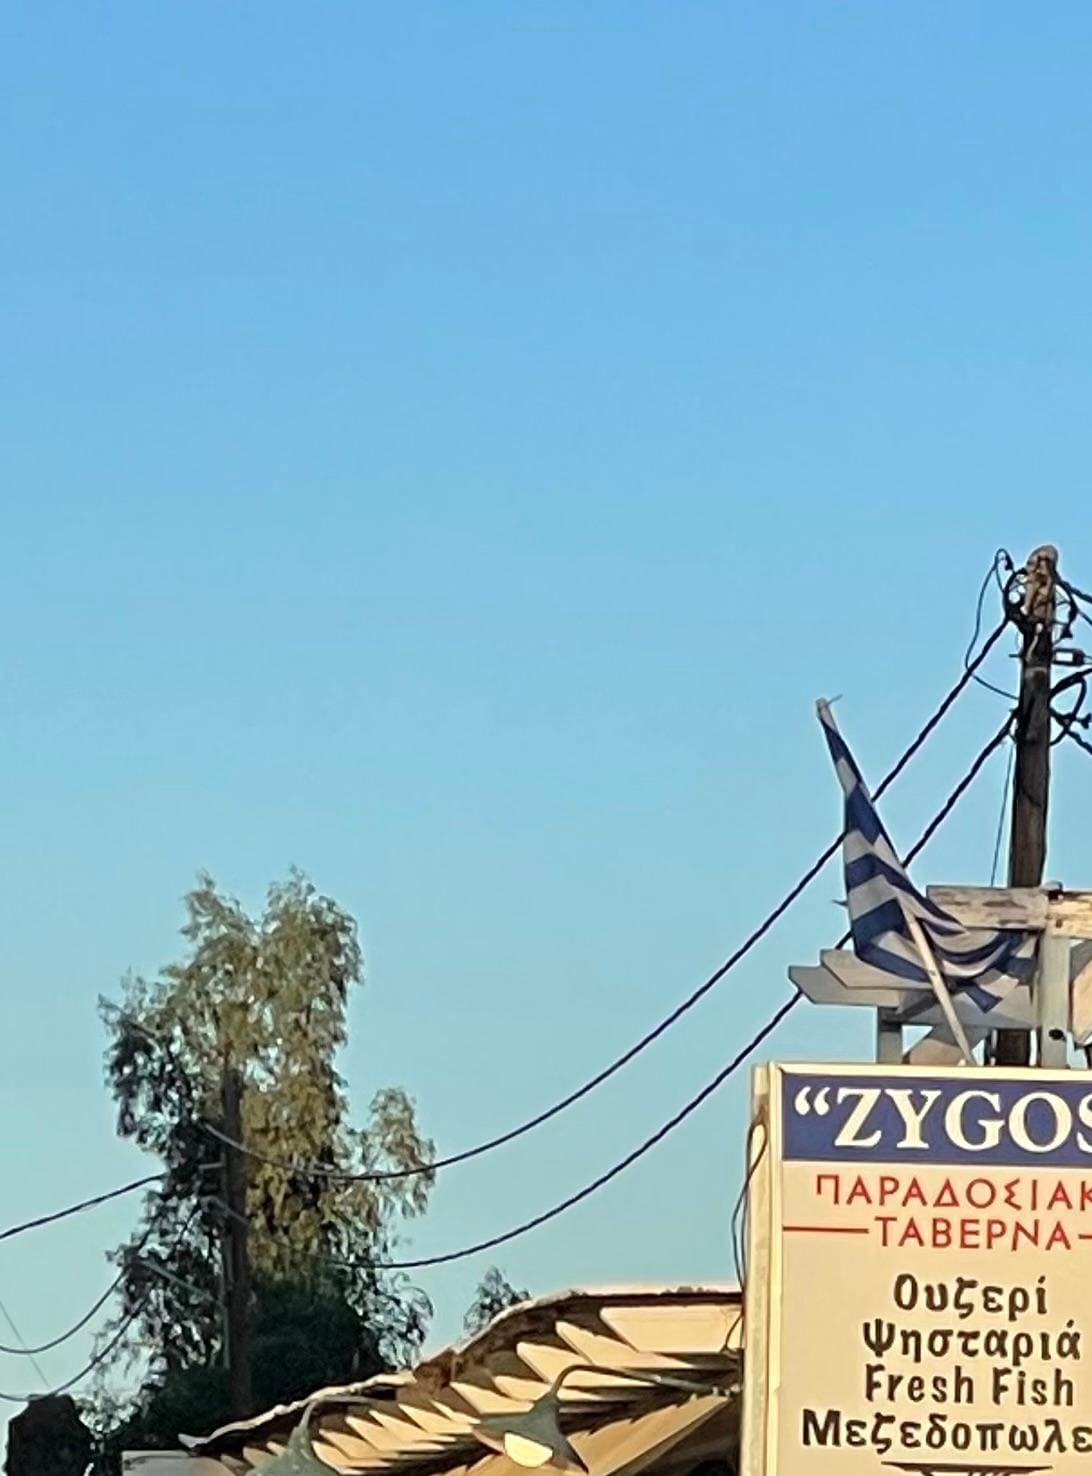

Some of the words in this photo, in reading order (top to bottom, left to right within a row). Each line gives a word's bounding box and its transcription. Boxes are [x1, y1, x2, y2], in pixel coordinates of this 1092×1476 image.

[874, 1216, 1072, 1252] ΤΑΒΕΡΝΑ
[894, 1273, 1048, 1321] Ουζερί
[863, 1318, 1081, 1366] Ψησταριά
[865, 1364, 974, 1404] Fresh
[992, 1368, 1074, 1406] Fish
